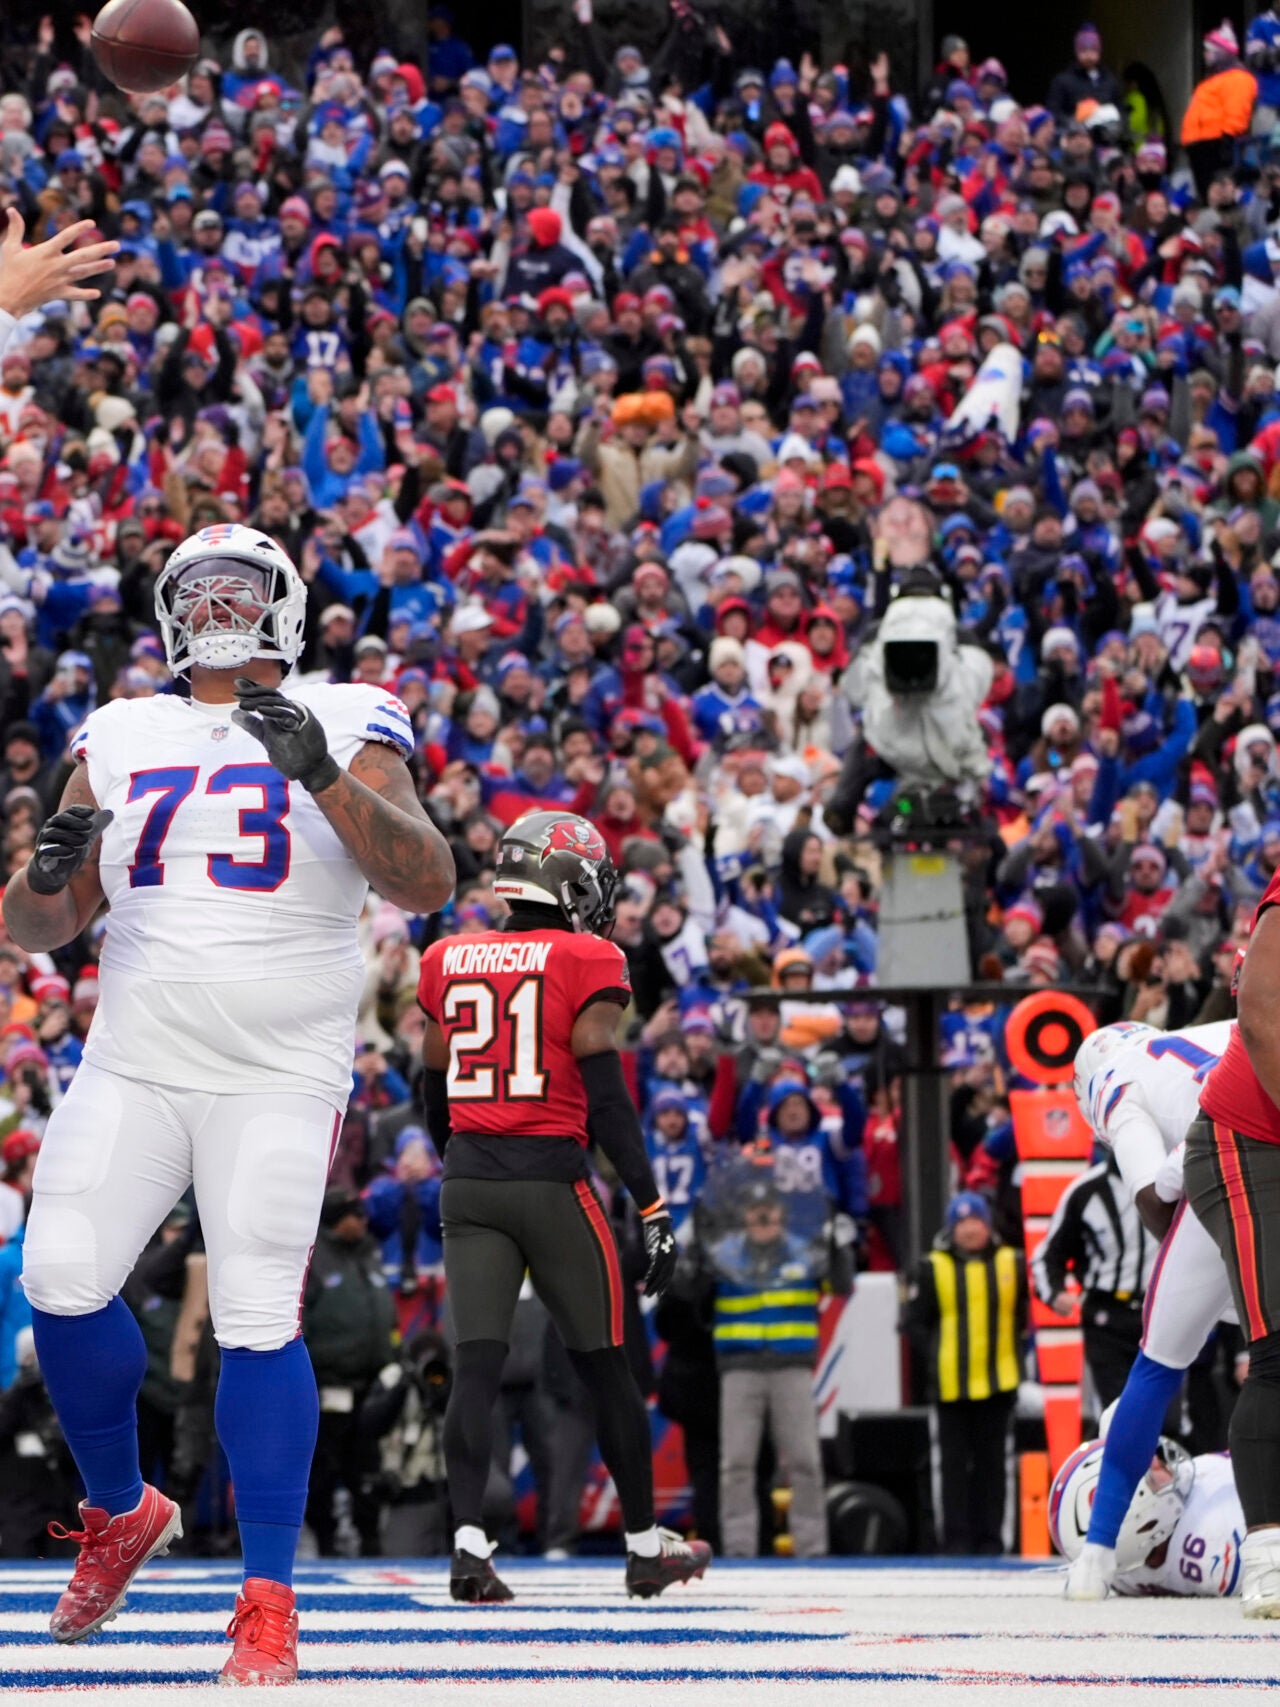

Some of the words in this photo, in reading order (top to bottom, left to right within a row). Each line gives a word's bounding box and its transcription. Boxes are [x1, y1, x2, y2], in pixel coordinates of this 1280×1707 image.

[306, 331, 338, 366] 17
[125, 762, 291, 892] 73
[443, 942, 552, 976] MORRISON
[442, 974, 550, 1103] 21
[653, 1152, 692, 1205] 17
